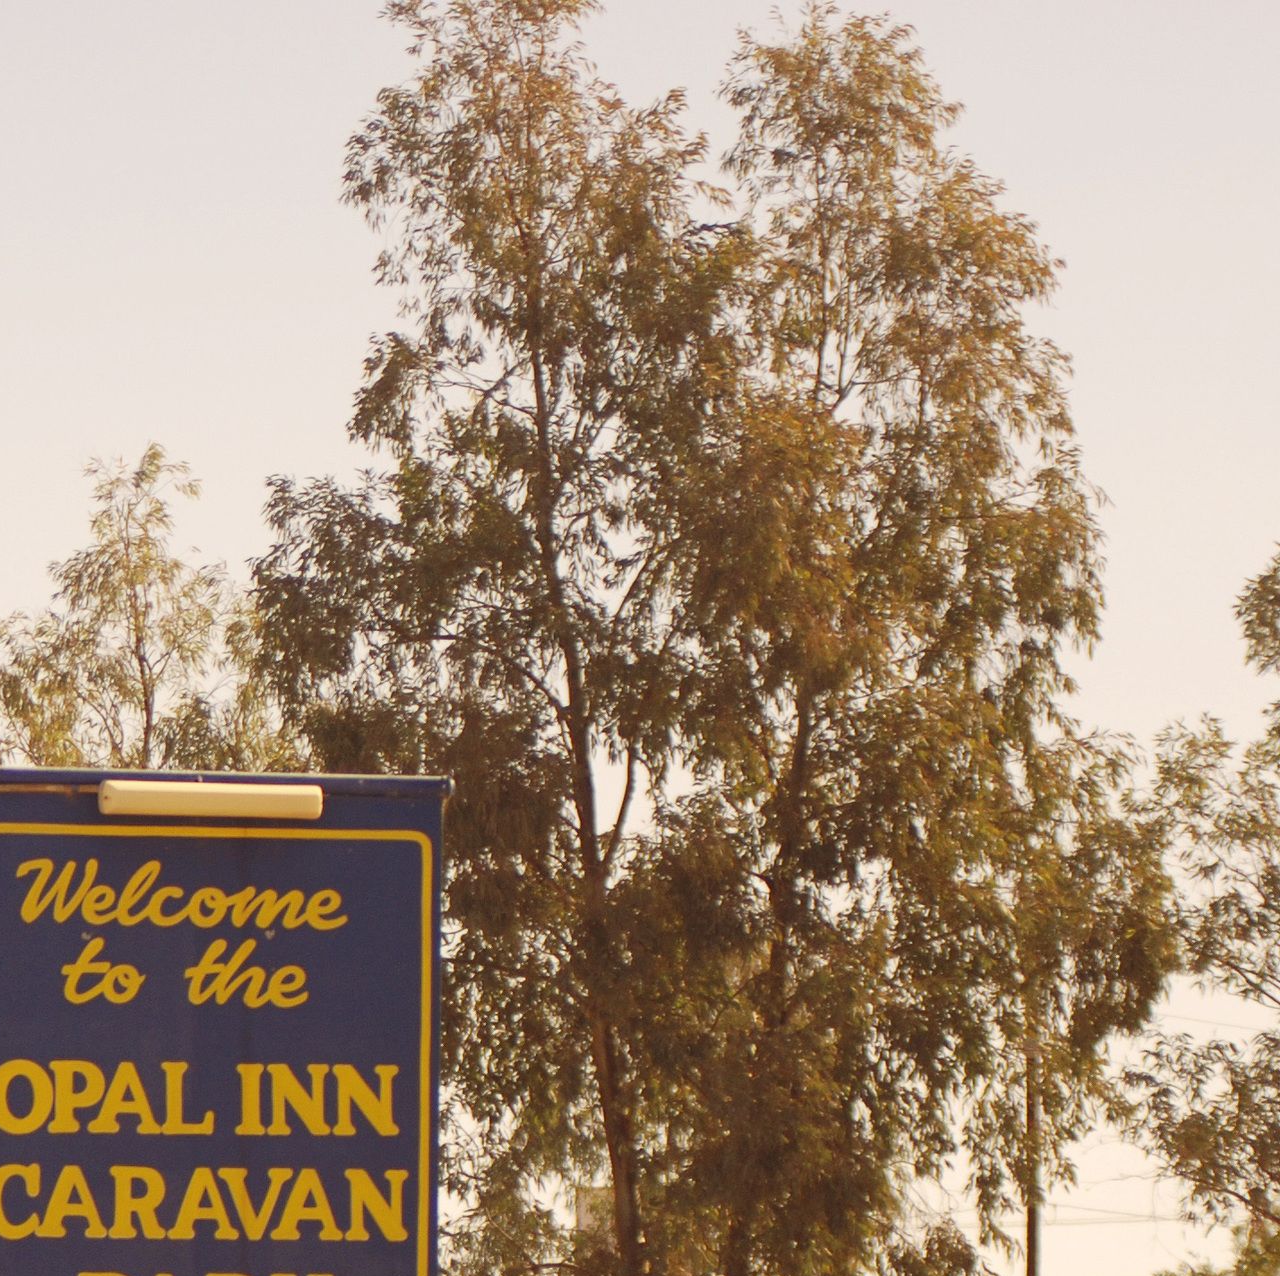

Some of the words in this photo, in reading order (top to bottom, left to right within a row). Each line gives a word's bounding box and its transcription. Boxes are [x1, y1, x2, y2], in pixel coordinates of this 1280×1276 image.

[17, 858, 348, 931] Welcome
[62, 937, 146, 1004] to
[185, 938, 309, 1008] the
[235, 1063, 400, 1136] INN
